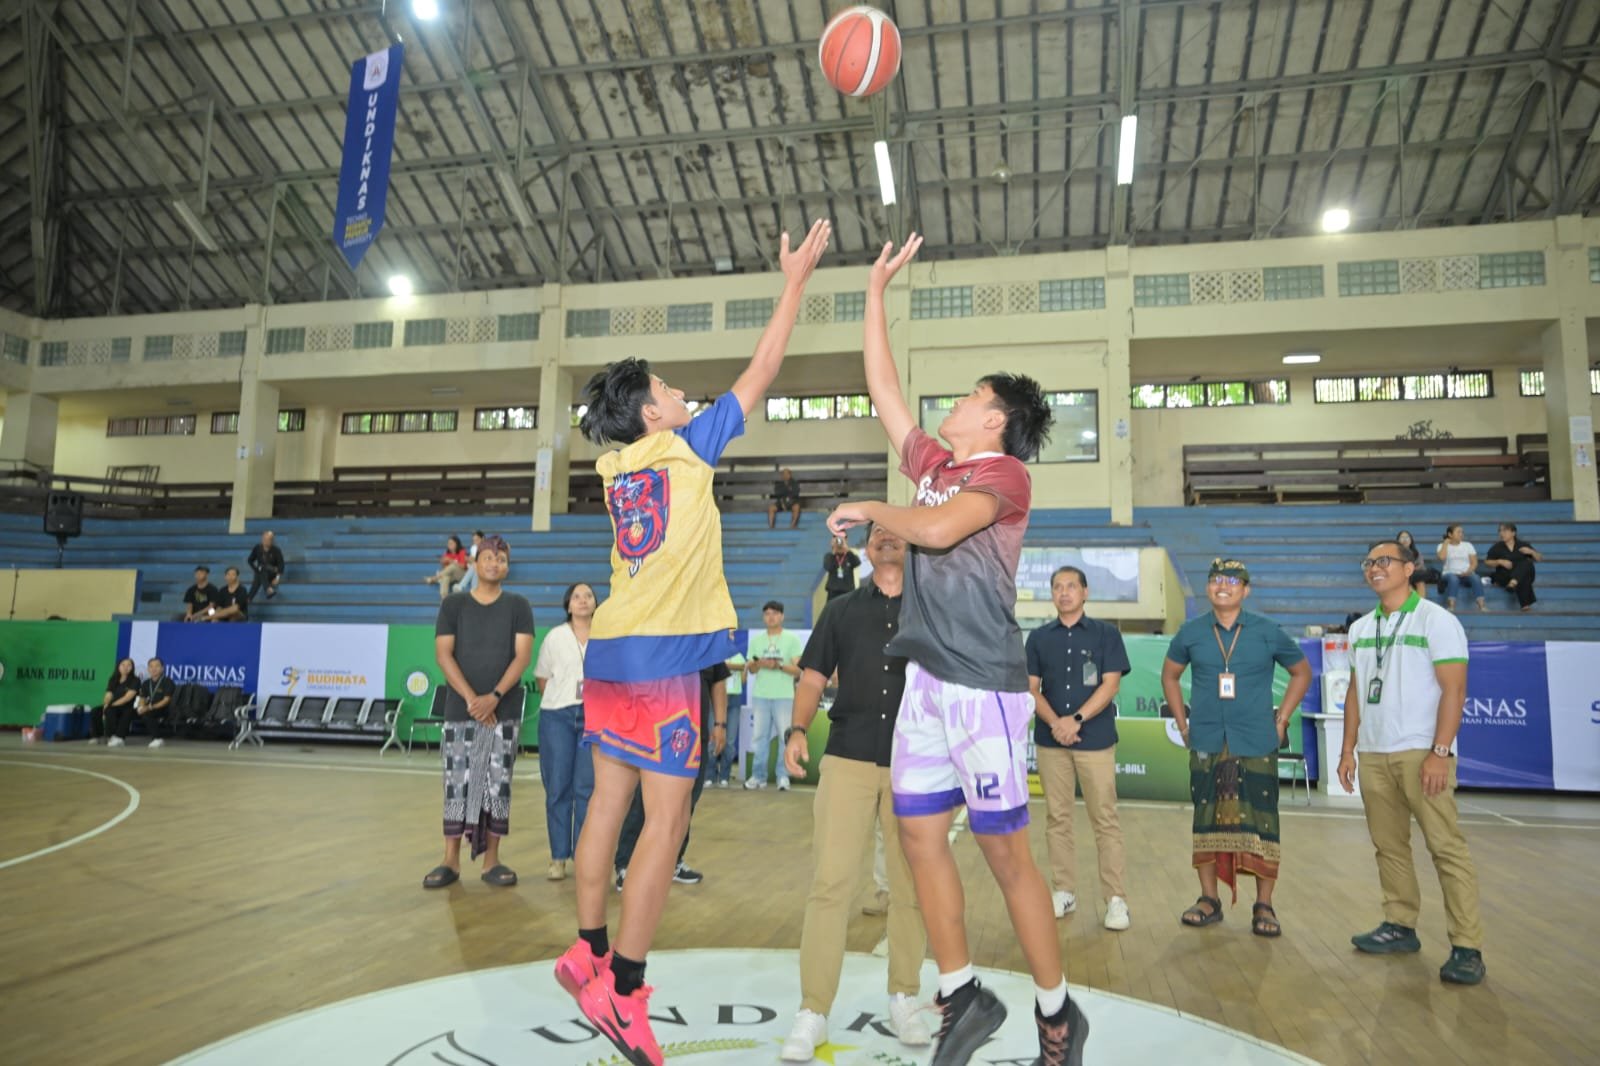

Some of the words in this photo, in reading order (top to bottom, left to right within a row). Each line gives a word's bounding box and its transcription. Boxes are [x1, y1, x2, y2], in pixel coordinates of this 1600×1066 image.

[357, 92, 378, 211] UNDIKNAS
[16, 667, 45, 680] BANK
[47, 668, 69, 681] BPD
[71, 668, 96, 682] BALI
[307, 674, 367, 686] BUDINATA
[1462, 697, 1527, 718] KNAS
[974, 772, 1001, 800] 12
